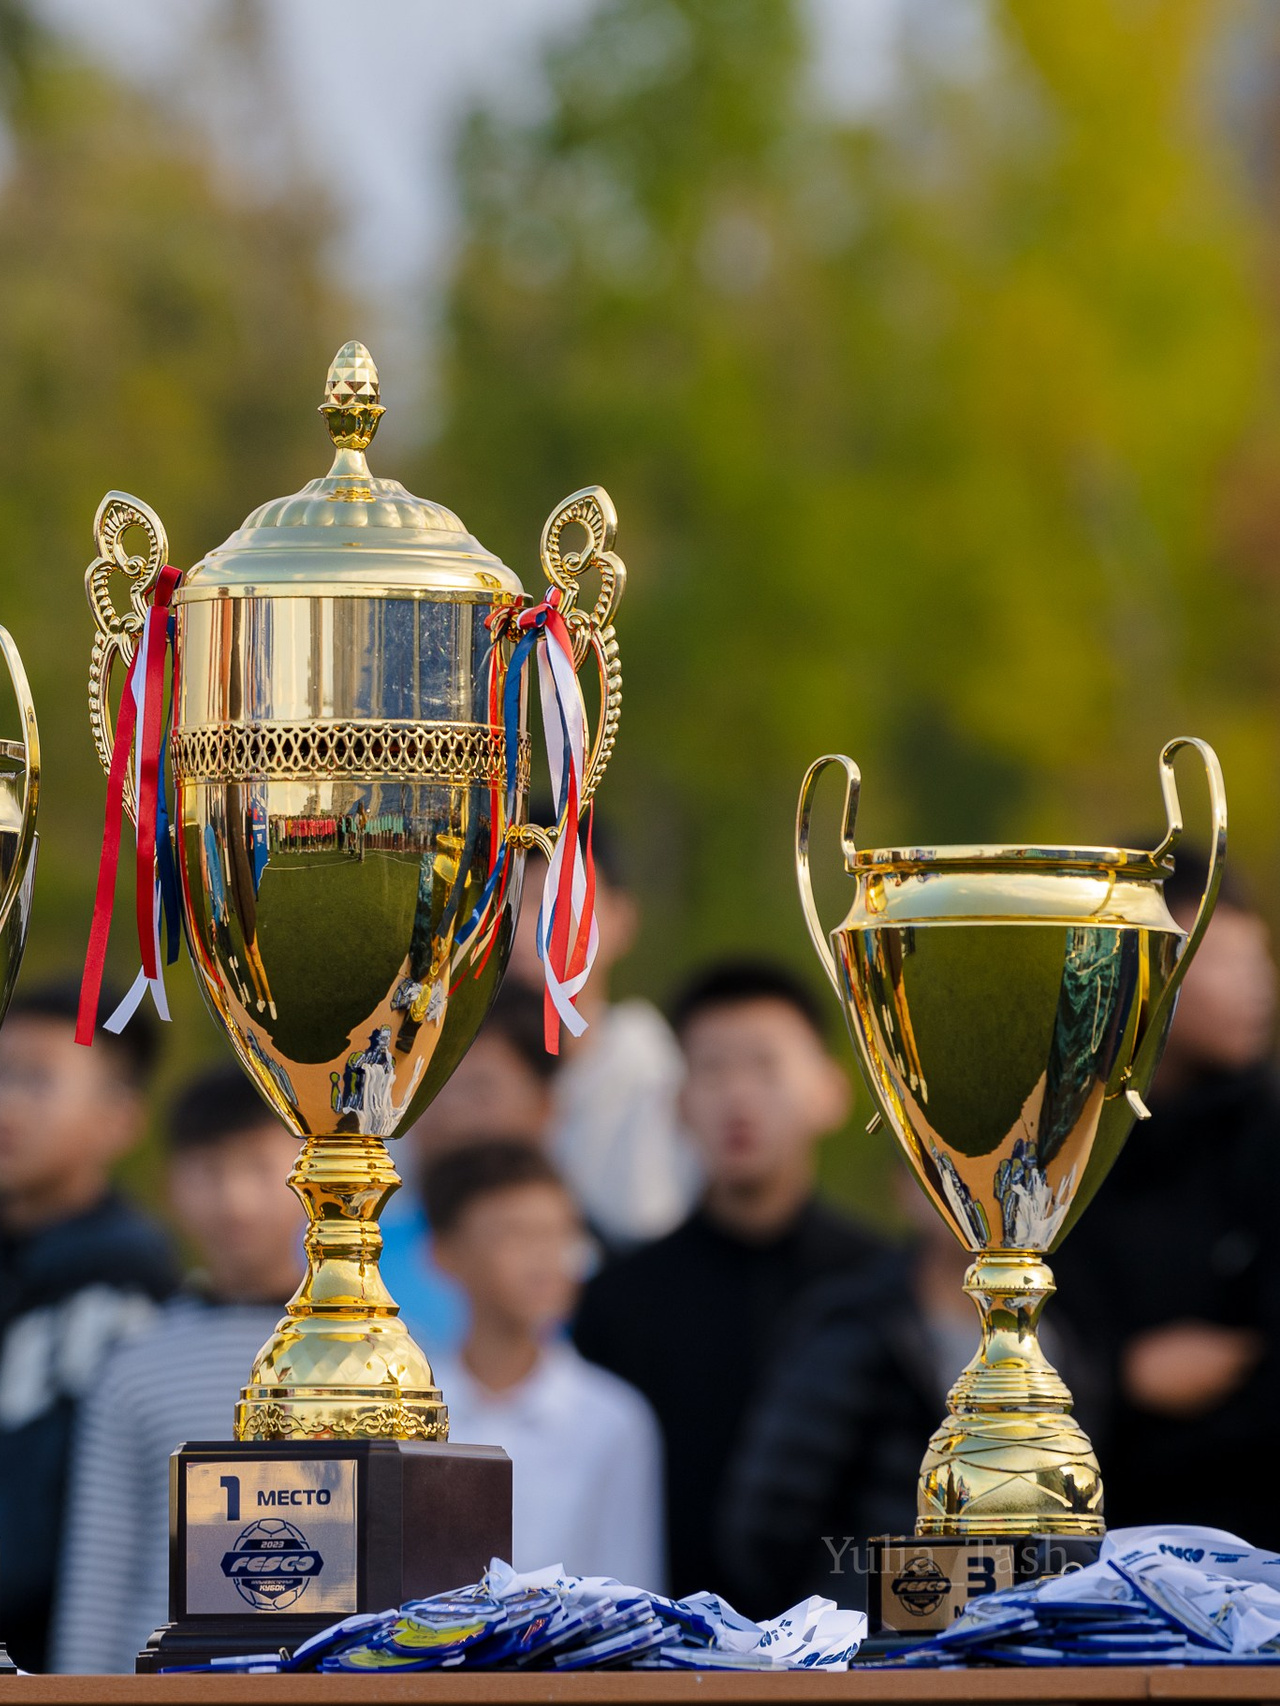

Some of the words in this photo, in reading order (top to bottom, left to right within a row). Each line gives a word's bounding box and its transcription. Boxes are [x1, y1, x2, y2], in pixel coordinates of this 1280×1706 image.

[220, 1475, 240, 1521] 1
[257, 1489, 331, 1506] МЕСТО
[260, 1541, 285, 1549] 2023
[230, 1556, 315, 1572] FESCO
[967, 1557, 996, 1598] 3
[259, 1584, 286, 1592] КУБОК
[897, 1581, 947, 1592] FESCO
